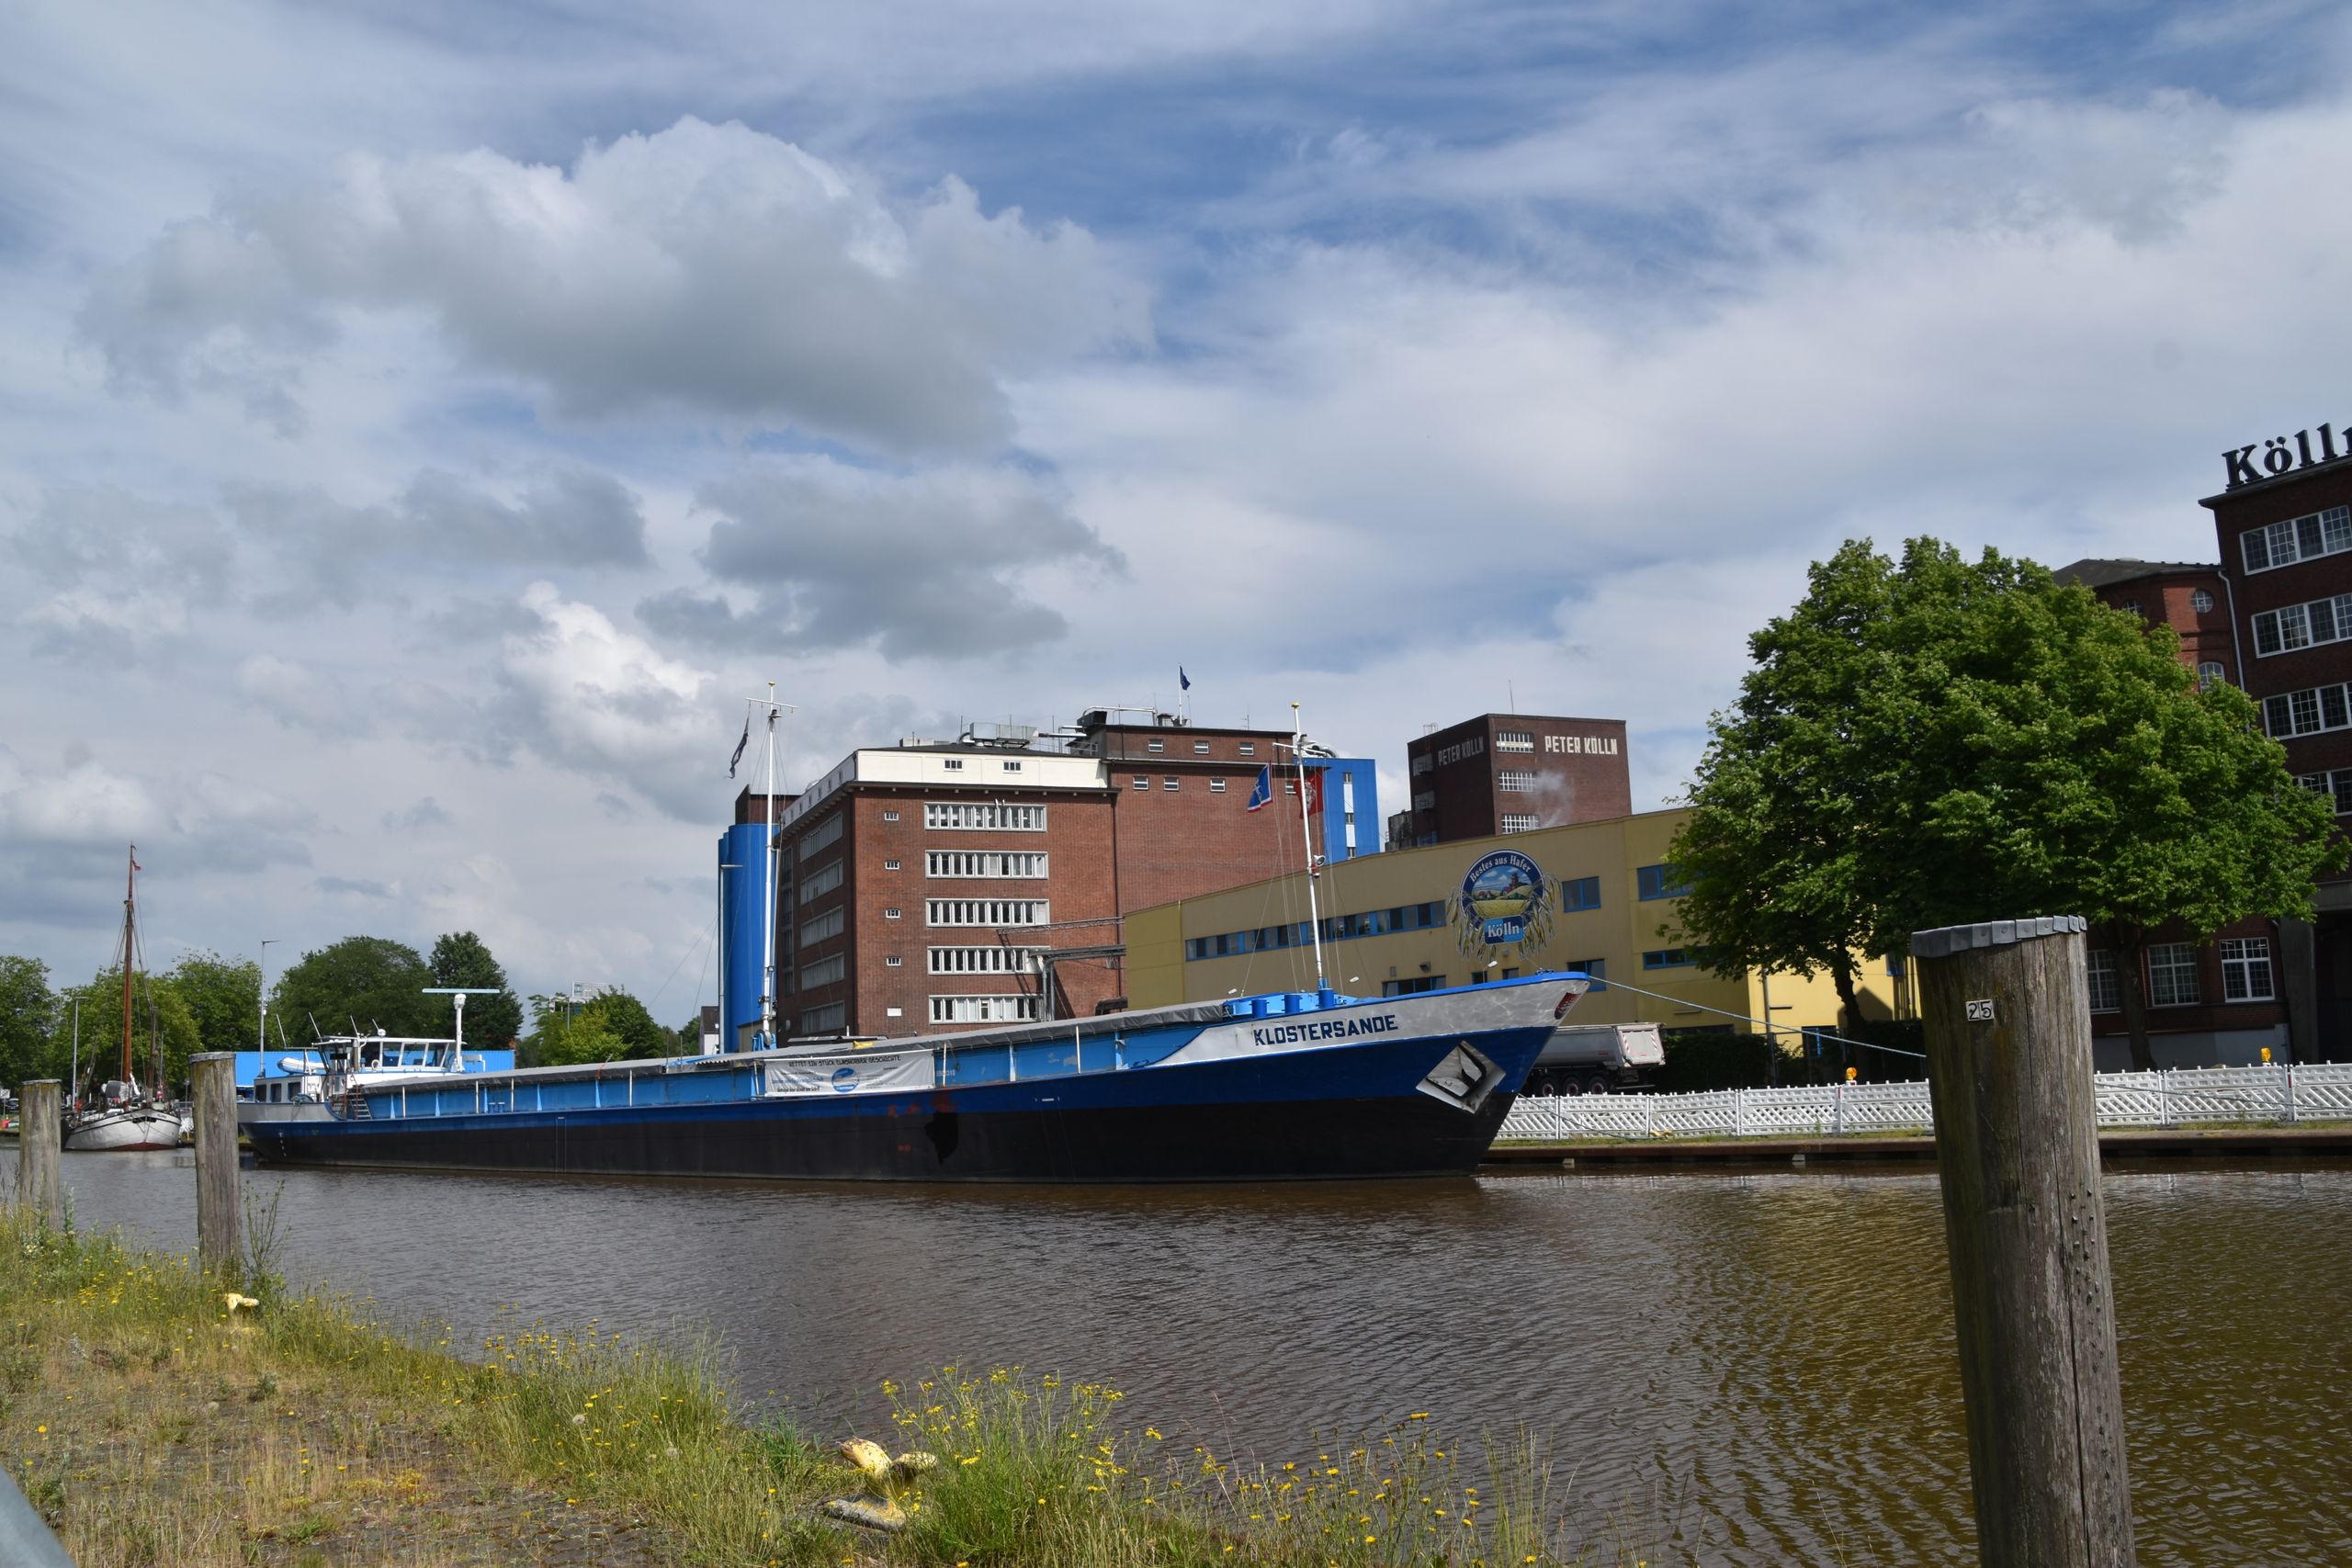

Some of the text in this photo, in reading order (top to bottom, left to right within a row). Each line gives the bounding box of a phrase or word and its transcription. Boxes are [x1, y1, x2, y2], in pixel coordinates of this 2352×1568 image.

[1438, 736, 1484, 766] PETER KÖLLN
[1544, 736, 1618, 755] PETER KÖLLN
[1470, 855, 1531, 882] Bestes aus Hafer
[1488, 921, 1520, 937] Kölln
[1968, 1000, 1992, 1020] 25
[1253, 1014, 1398, 1046] KLOSTERSANDE
